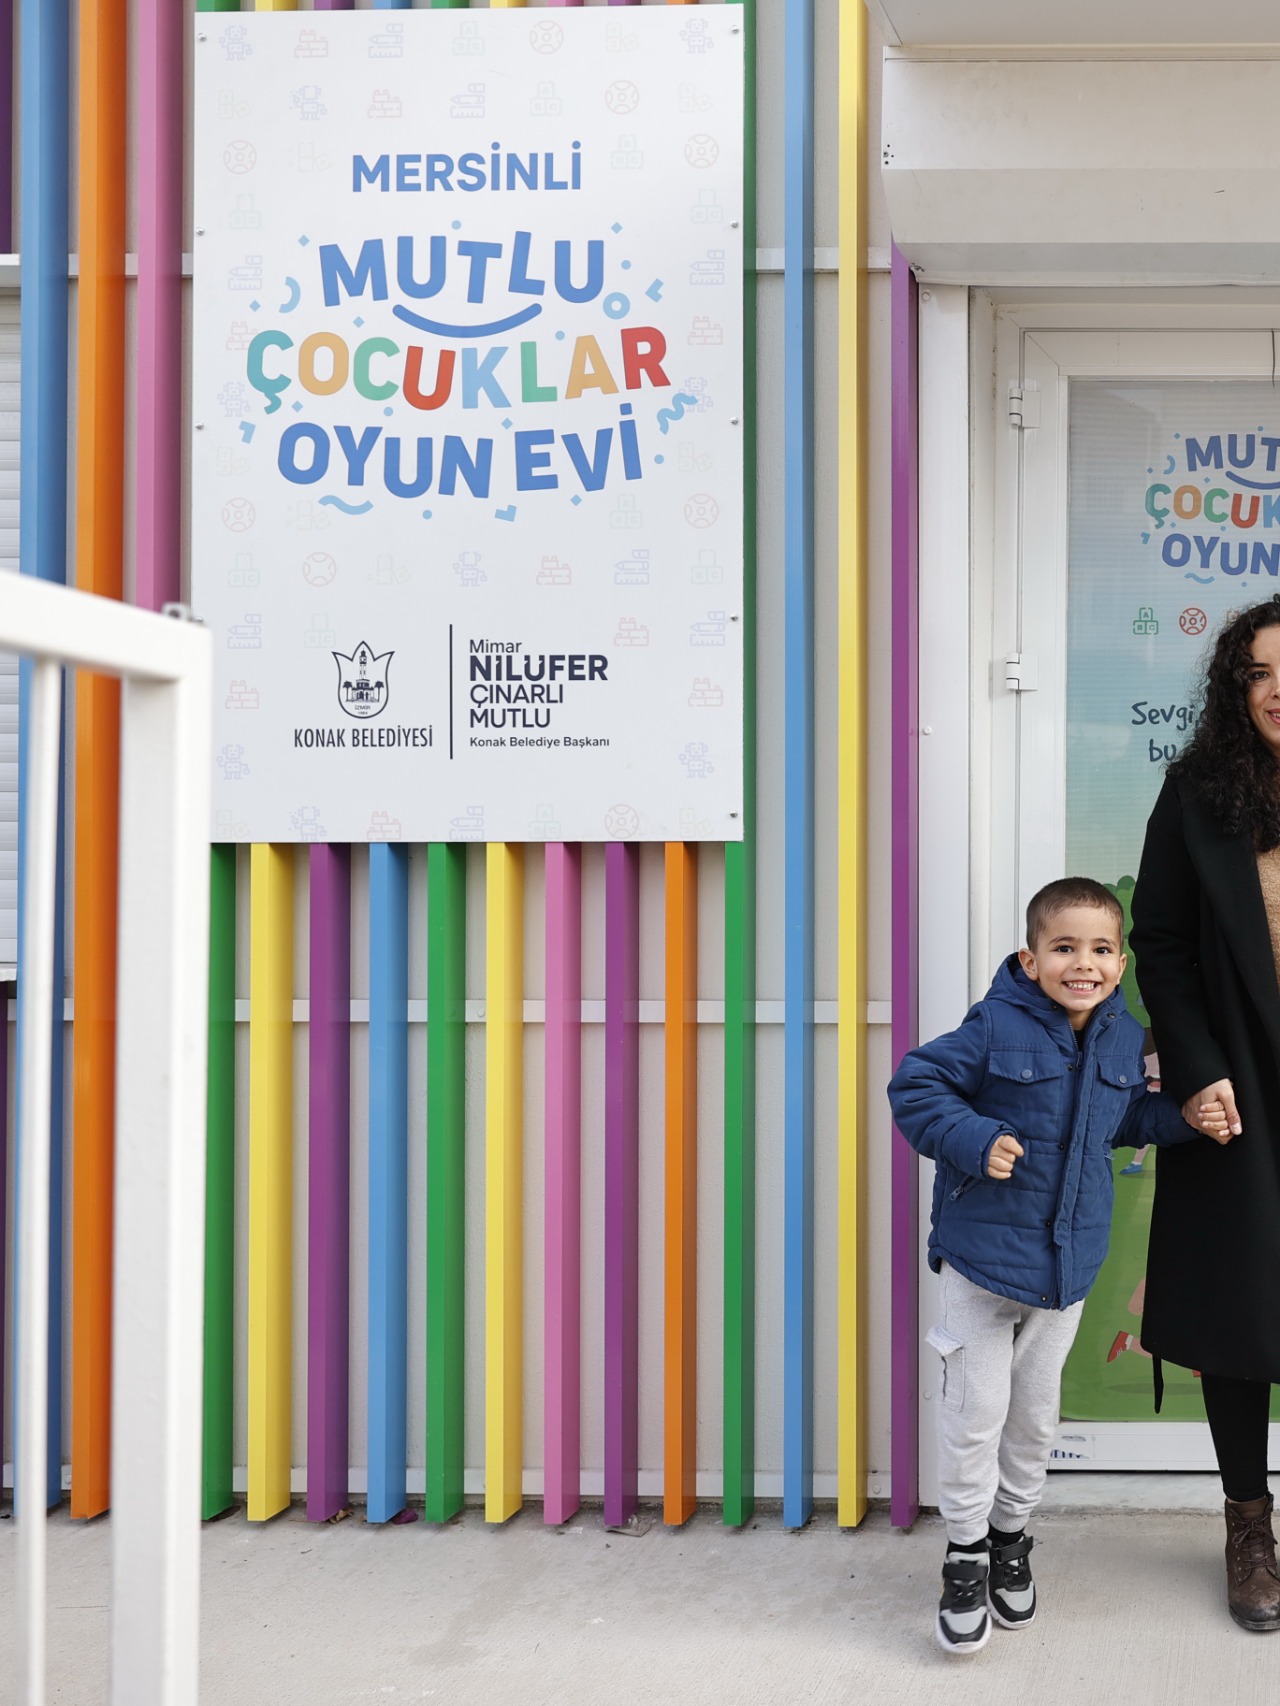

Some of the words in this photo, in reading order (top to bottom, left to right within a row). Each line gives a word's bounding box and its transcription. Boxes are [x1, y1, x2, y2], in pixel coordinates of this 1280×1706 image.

[352, 140, 581, 193] MERSİNLİ
[319, 231, 605, 307] MUTLU
[246, 326, 671, 415] ÇOCUKLAR
[277, 422, 493, 499] OYUN
[514, 403, 643, 492] EVİ
[1161, 533, 1280, 576] OYUN
[469, 639, 523, 653] Mimar
[469, 684, 564, 709] ÇINARLI
[469, 708, 551, 729] MUTLU
[294, 729, 346, 748] KONAK
[351, 724, 433, 748] BELEDİYESİ
[469, 737, 507, 747] Konak
[509, 736, 561, 749] Belediye
[563, 736, 610, 749] Başkanı
